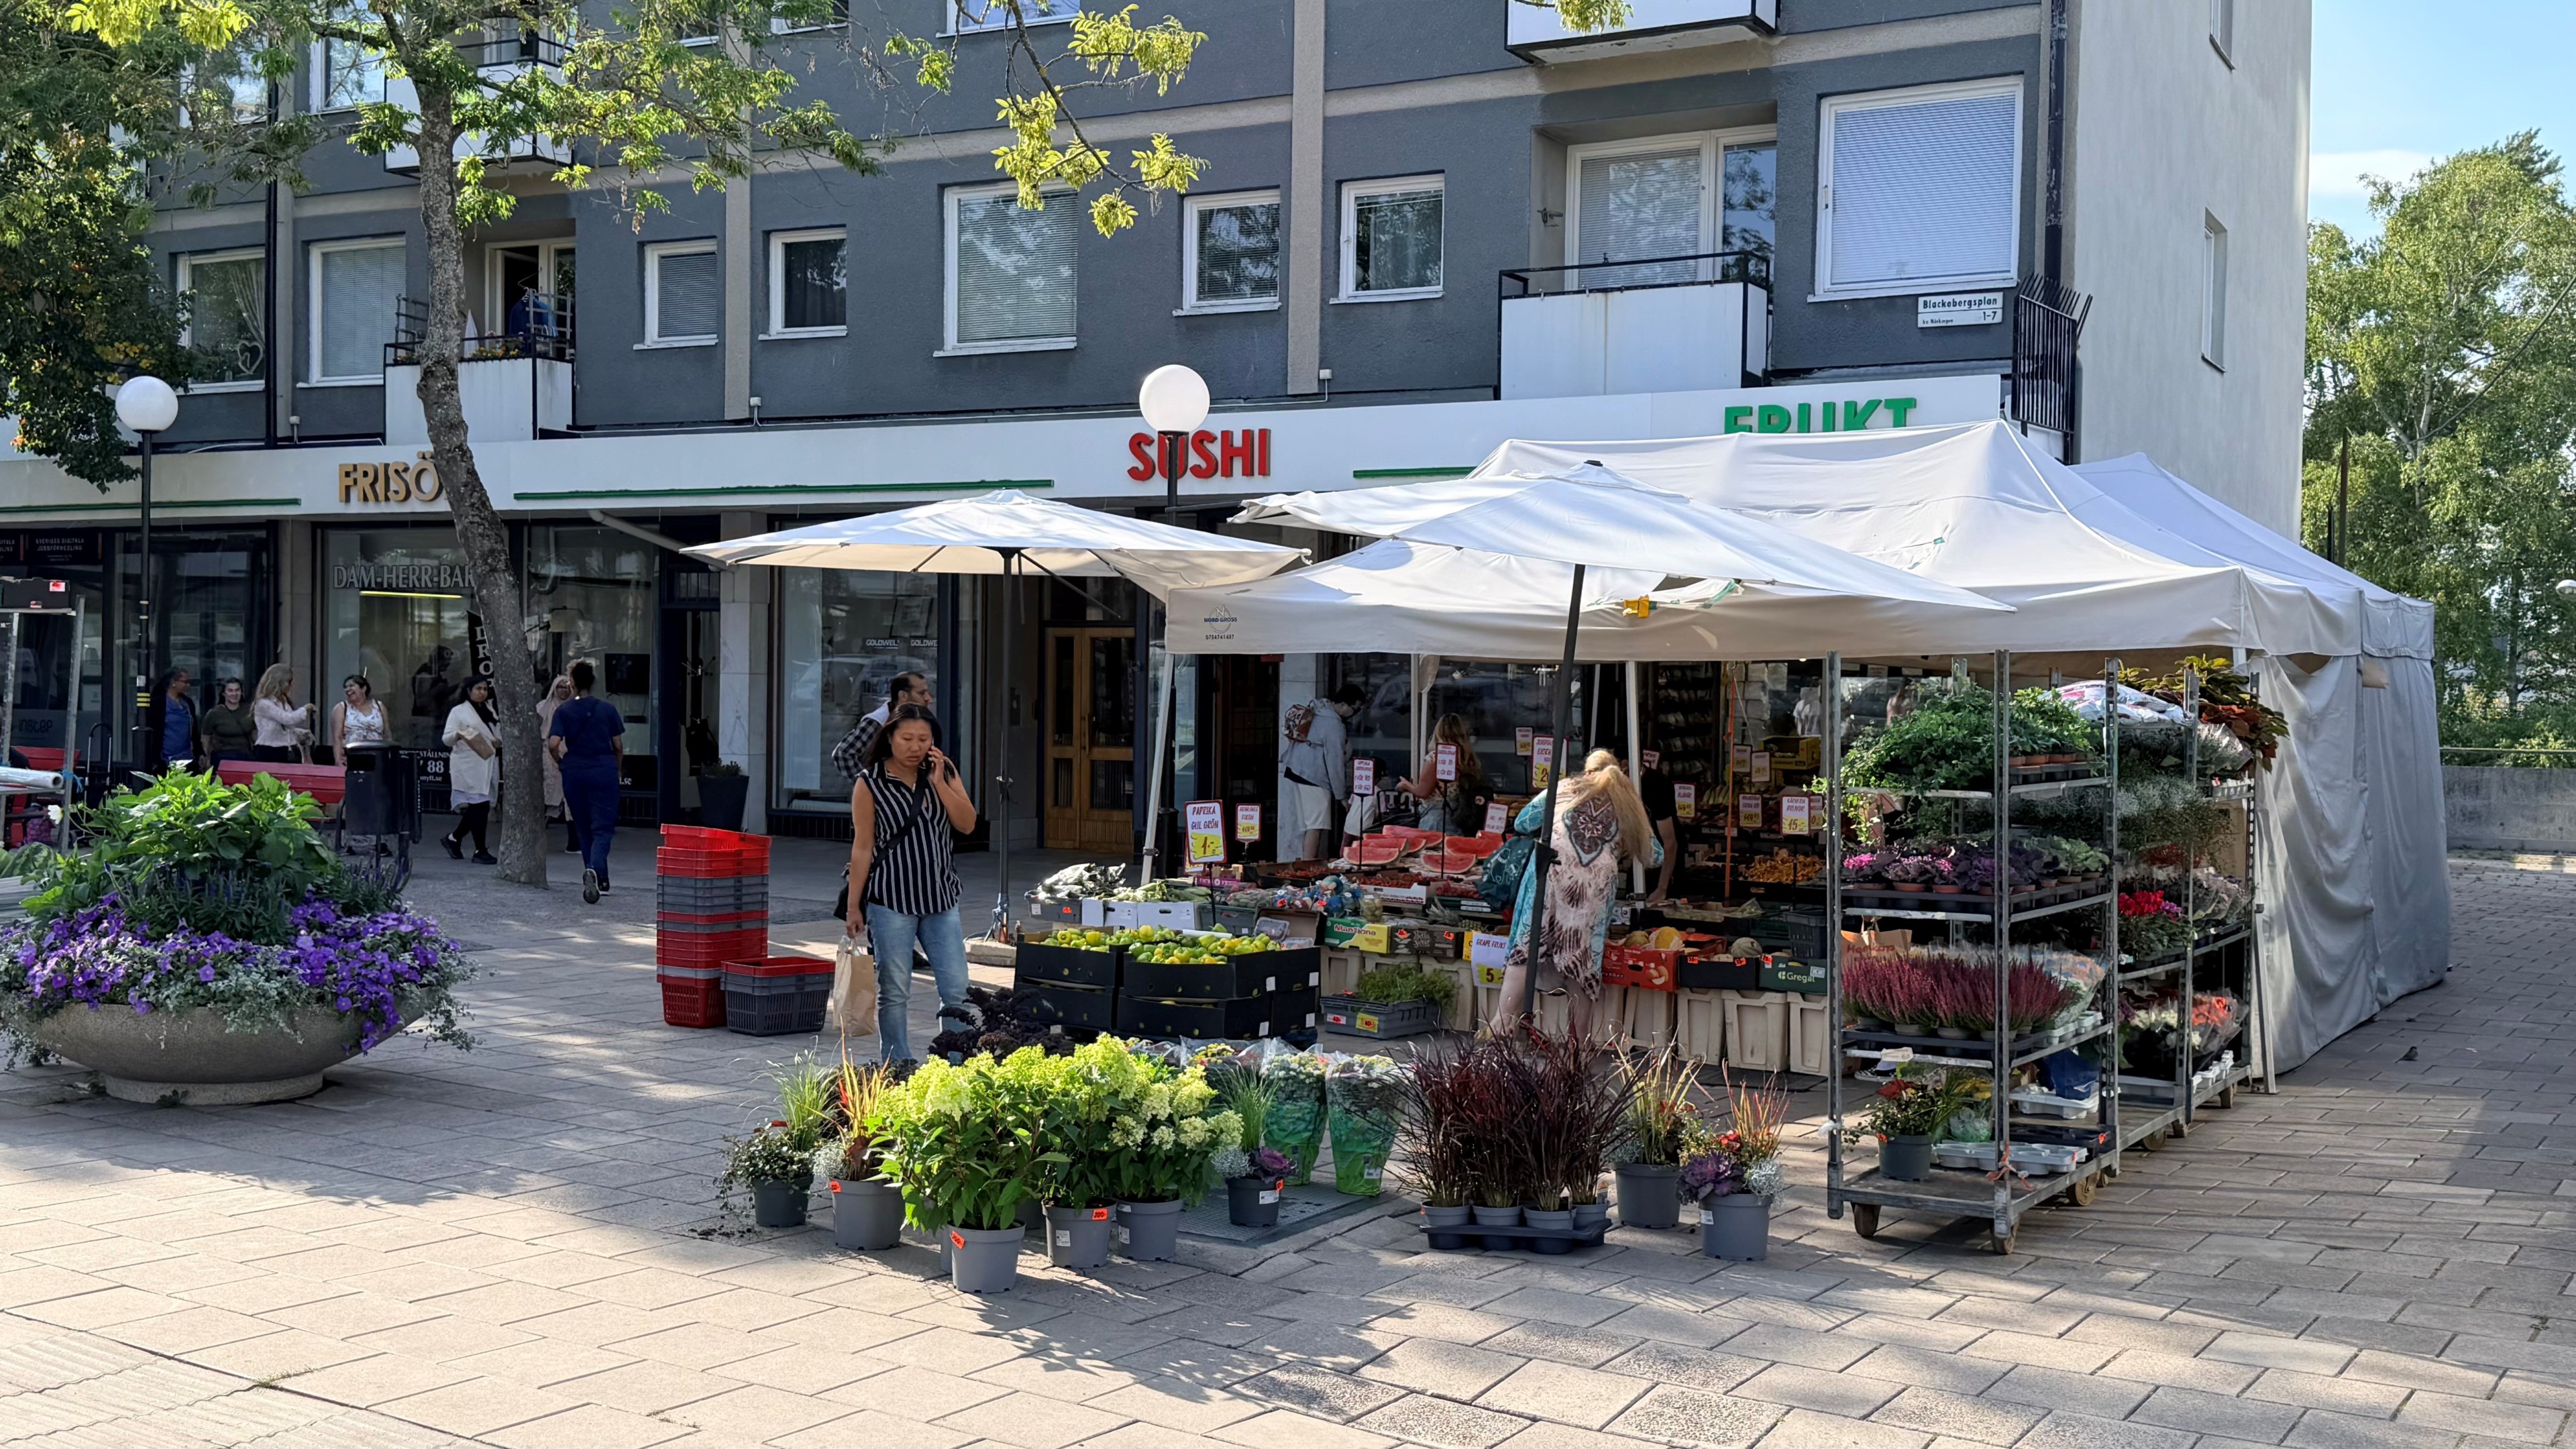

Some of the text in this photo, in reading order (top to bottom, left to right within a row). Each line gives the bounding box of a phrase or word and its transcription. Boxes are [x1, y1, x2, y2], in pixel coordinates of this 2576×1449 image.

[1923, 296, 1997, 309] Blackebergsplan
[1983, 311, 1997, 321] 1-7
[1127, 429, 1271, 481] SUSHI
[339, 451, 444, 503] FRISÖ
[333, 565, 476, 588] DAM-HERR-BAR
[427, 760, 444, 773] 88
[1192, 806, 1216, 815] PAPRIKA
[1191, 818, 1219, 830] GUL GRÖN
[1477, 938, 1491, 947] GRAPE
[1787, 973, 1815, 983] Gregal
